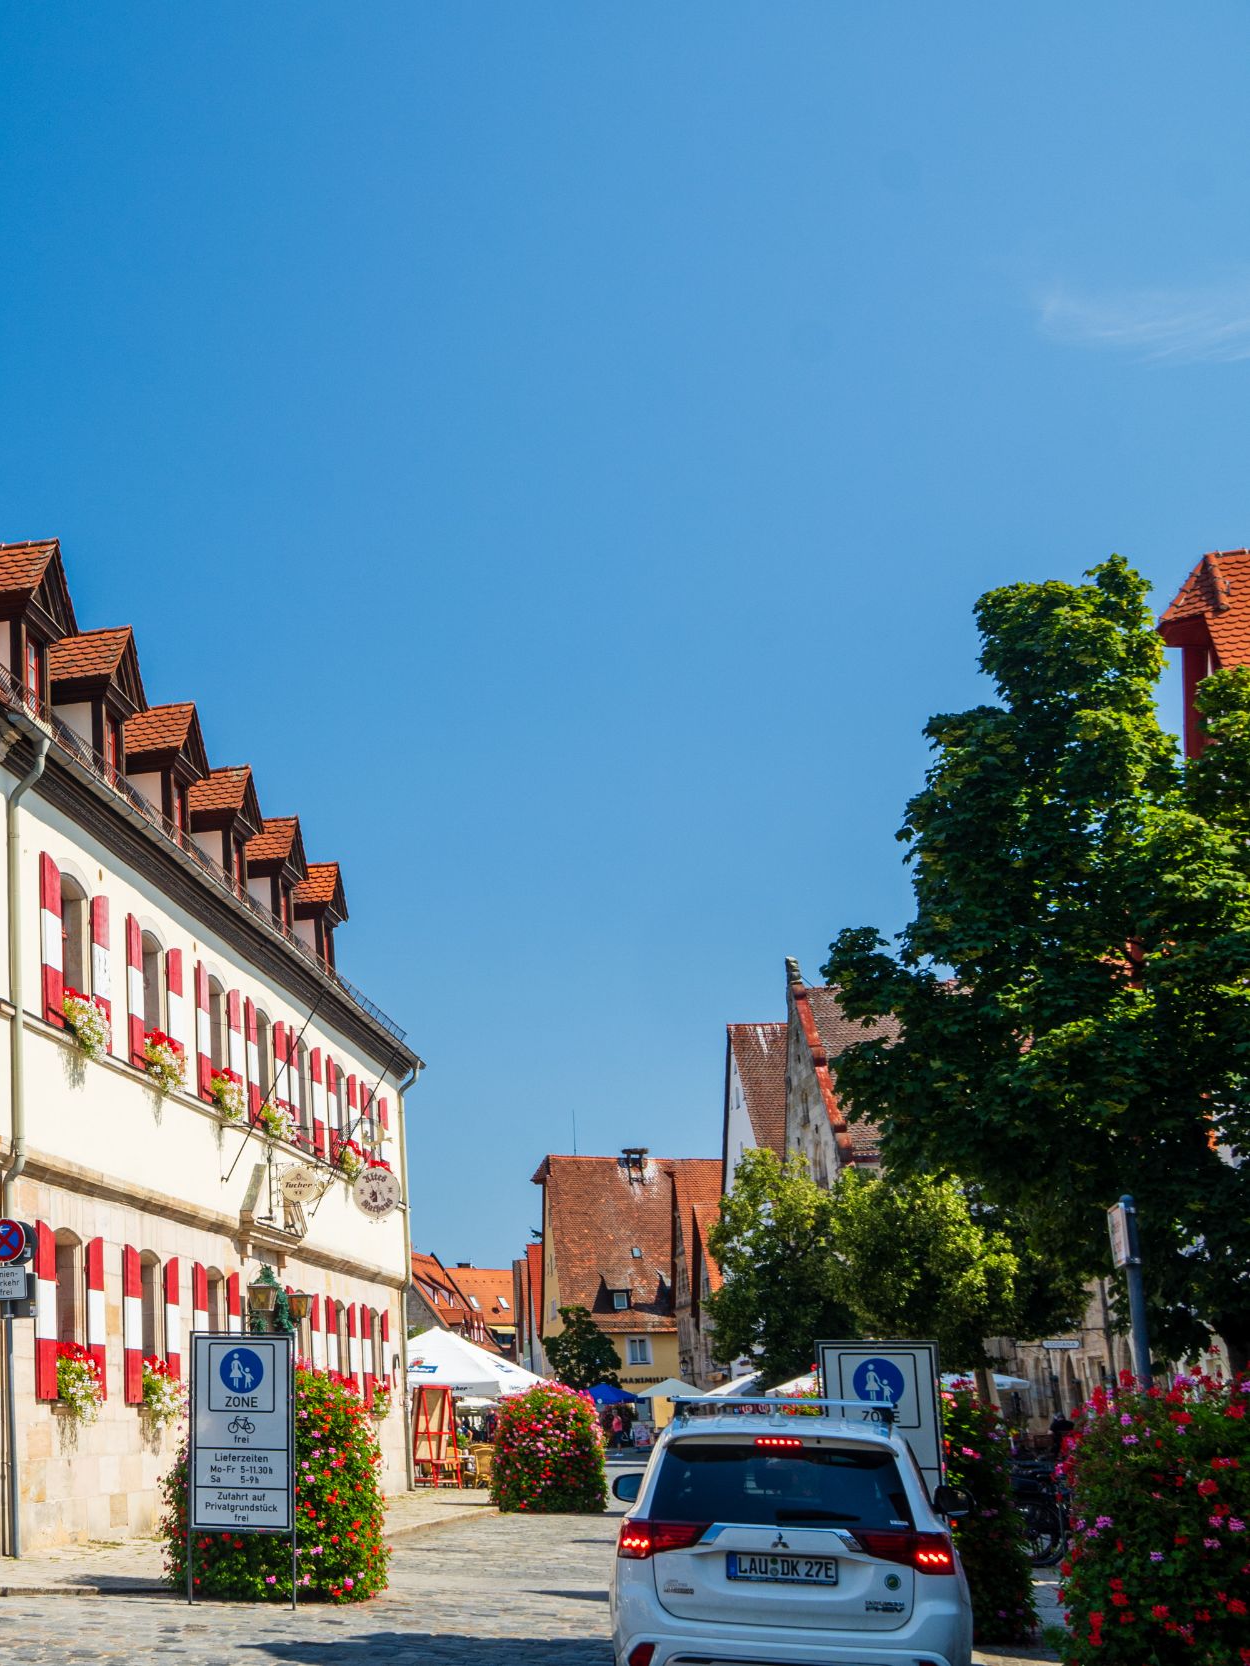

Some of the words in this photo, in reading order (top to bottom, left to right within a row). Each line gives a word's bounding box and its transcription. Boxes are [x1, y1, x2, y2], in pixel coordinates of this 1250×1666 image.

[285, 1181, 313, 1189] Tucher
[0, 1288, 13, 1296] frei
[225, 1395, 259, 1408] ZONE
[861, 1410, 901, 1423] ZOE
[234, 1434, 250, 1444] frei
[214, 1452, 269, 1463] Lieferzeiten
[210, 1464, 236, 1473] Mo-Fr
[210, 1474, 221, 1483] Sa
[217, 1491, 249, 1501] Zufahrt
[252, 1492, 266, 1501] auf
[205, 1501, 278, 1513] Privatgrundstück
[234, 1513, 249, 1522] frei
[738, 1556, 768, 1575] LAU
[781, 1559, 800, 1577] DK
[804, 1560, 834, 1579] 27E
